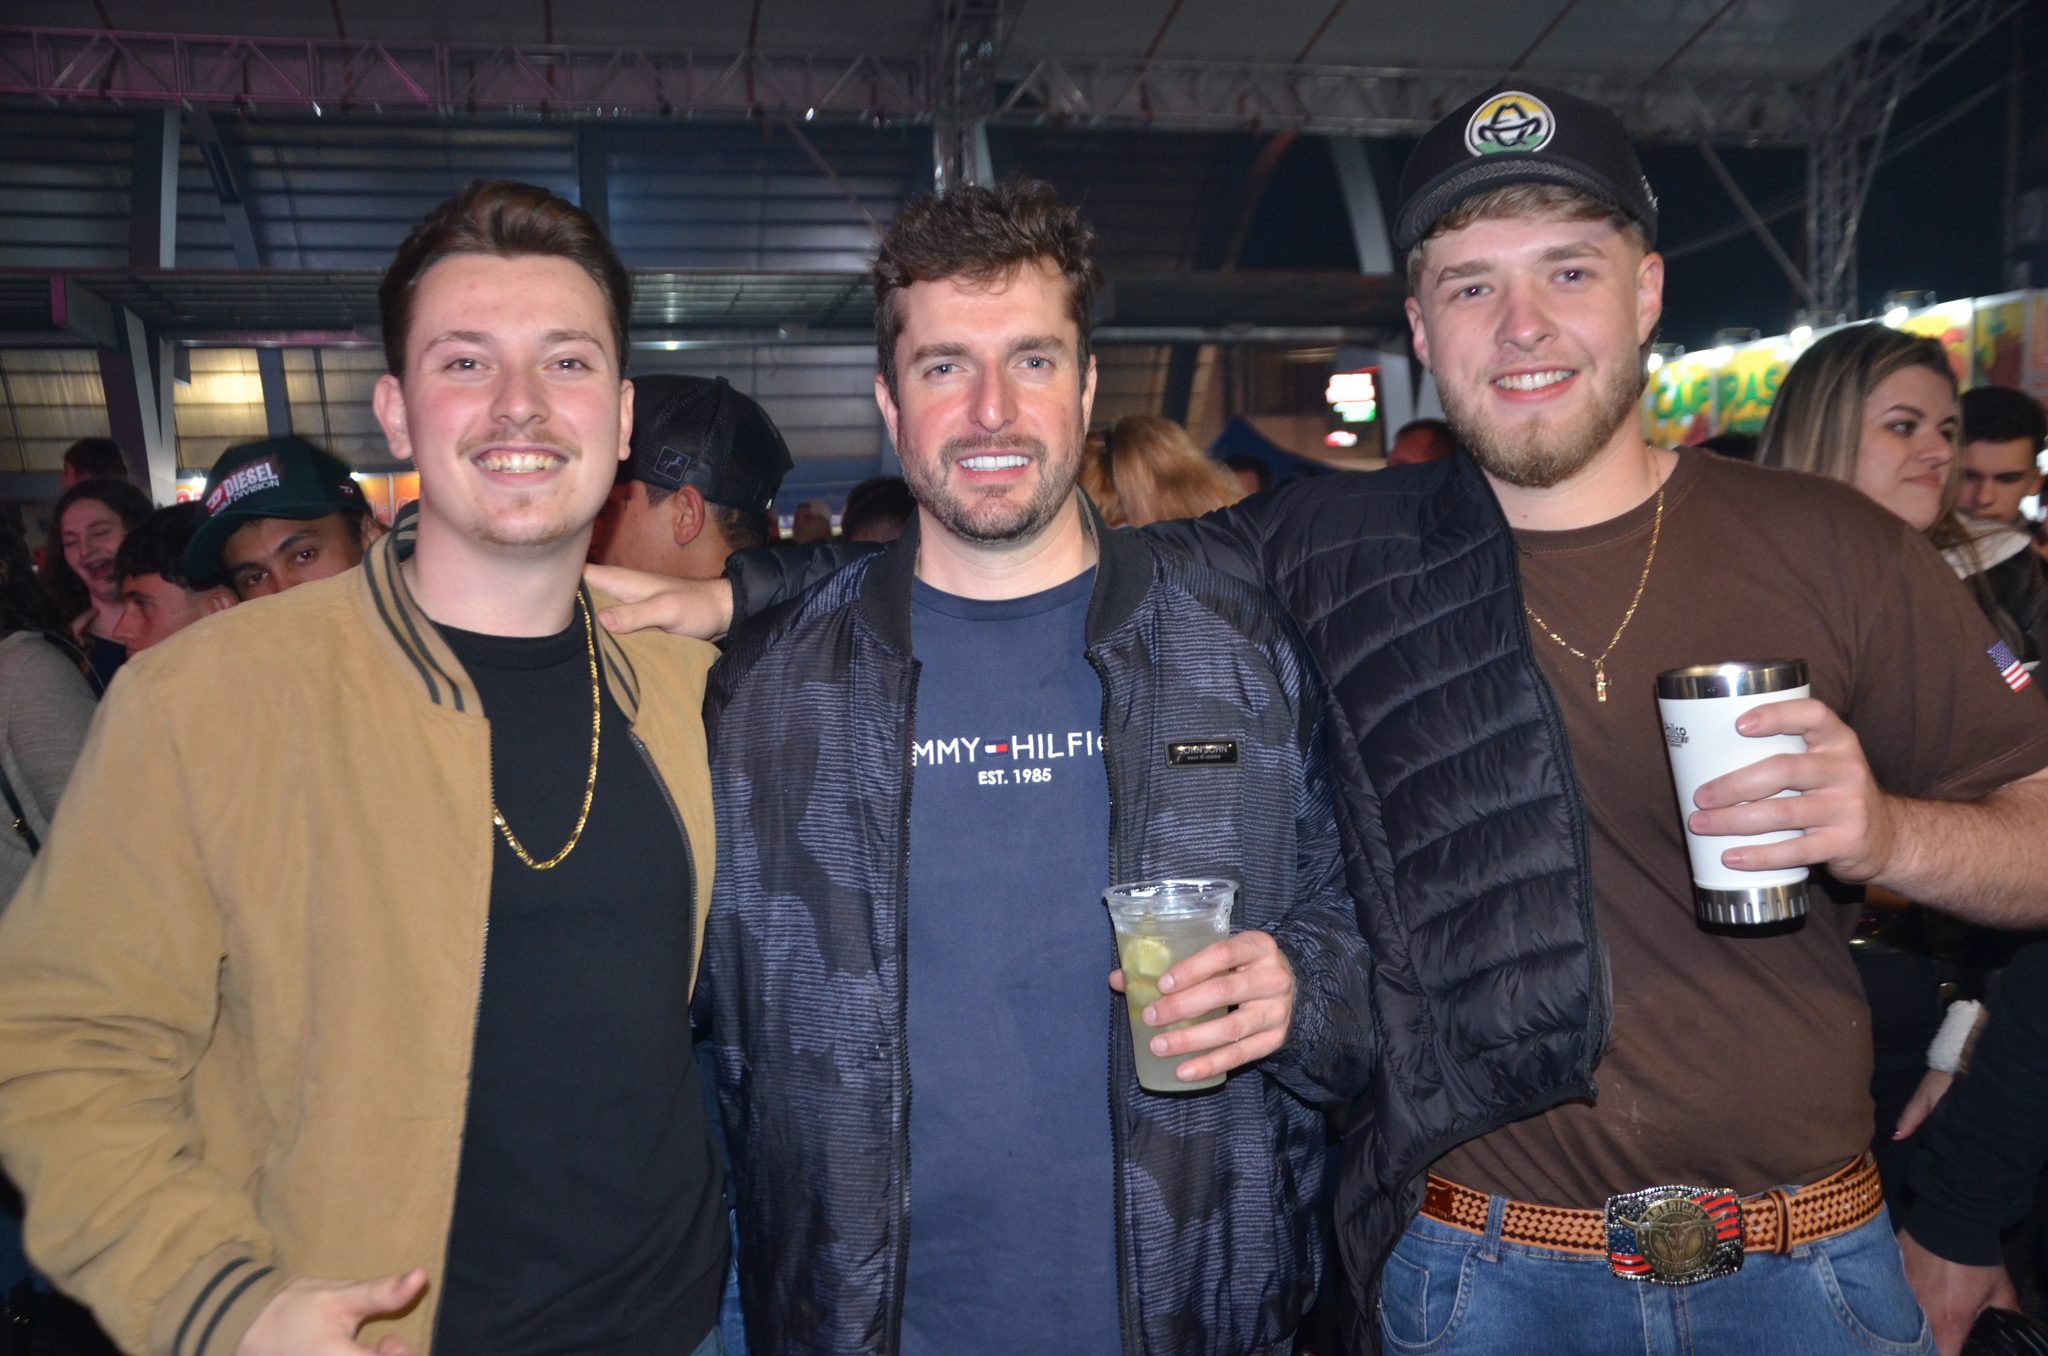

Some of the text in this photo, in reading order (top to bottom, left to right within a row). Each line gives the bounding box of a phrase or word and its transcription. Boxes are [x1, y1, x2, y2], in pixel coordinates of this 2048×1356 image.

[223, 462, 279, 498] DIESEL
[233, 478, 280, 502] DIVISION
[1011, 730, 1104, 761] HILFI
[977, 767, 1052, 785] EST. 1985
[1646, 1200, 1704, 1223] AMERICAN
